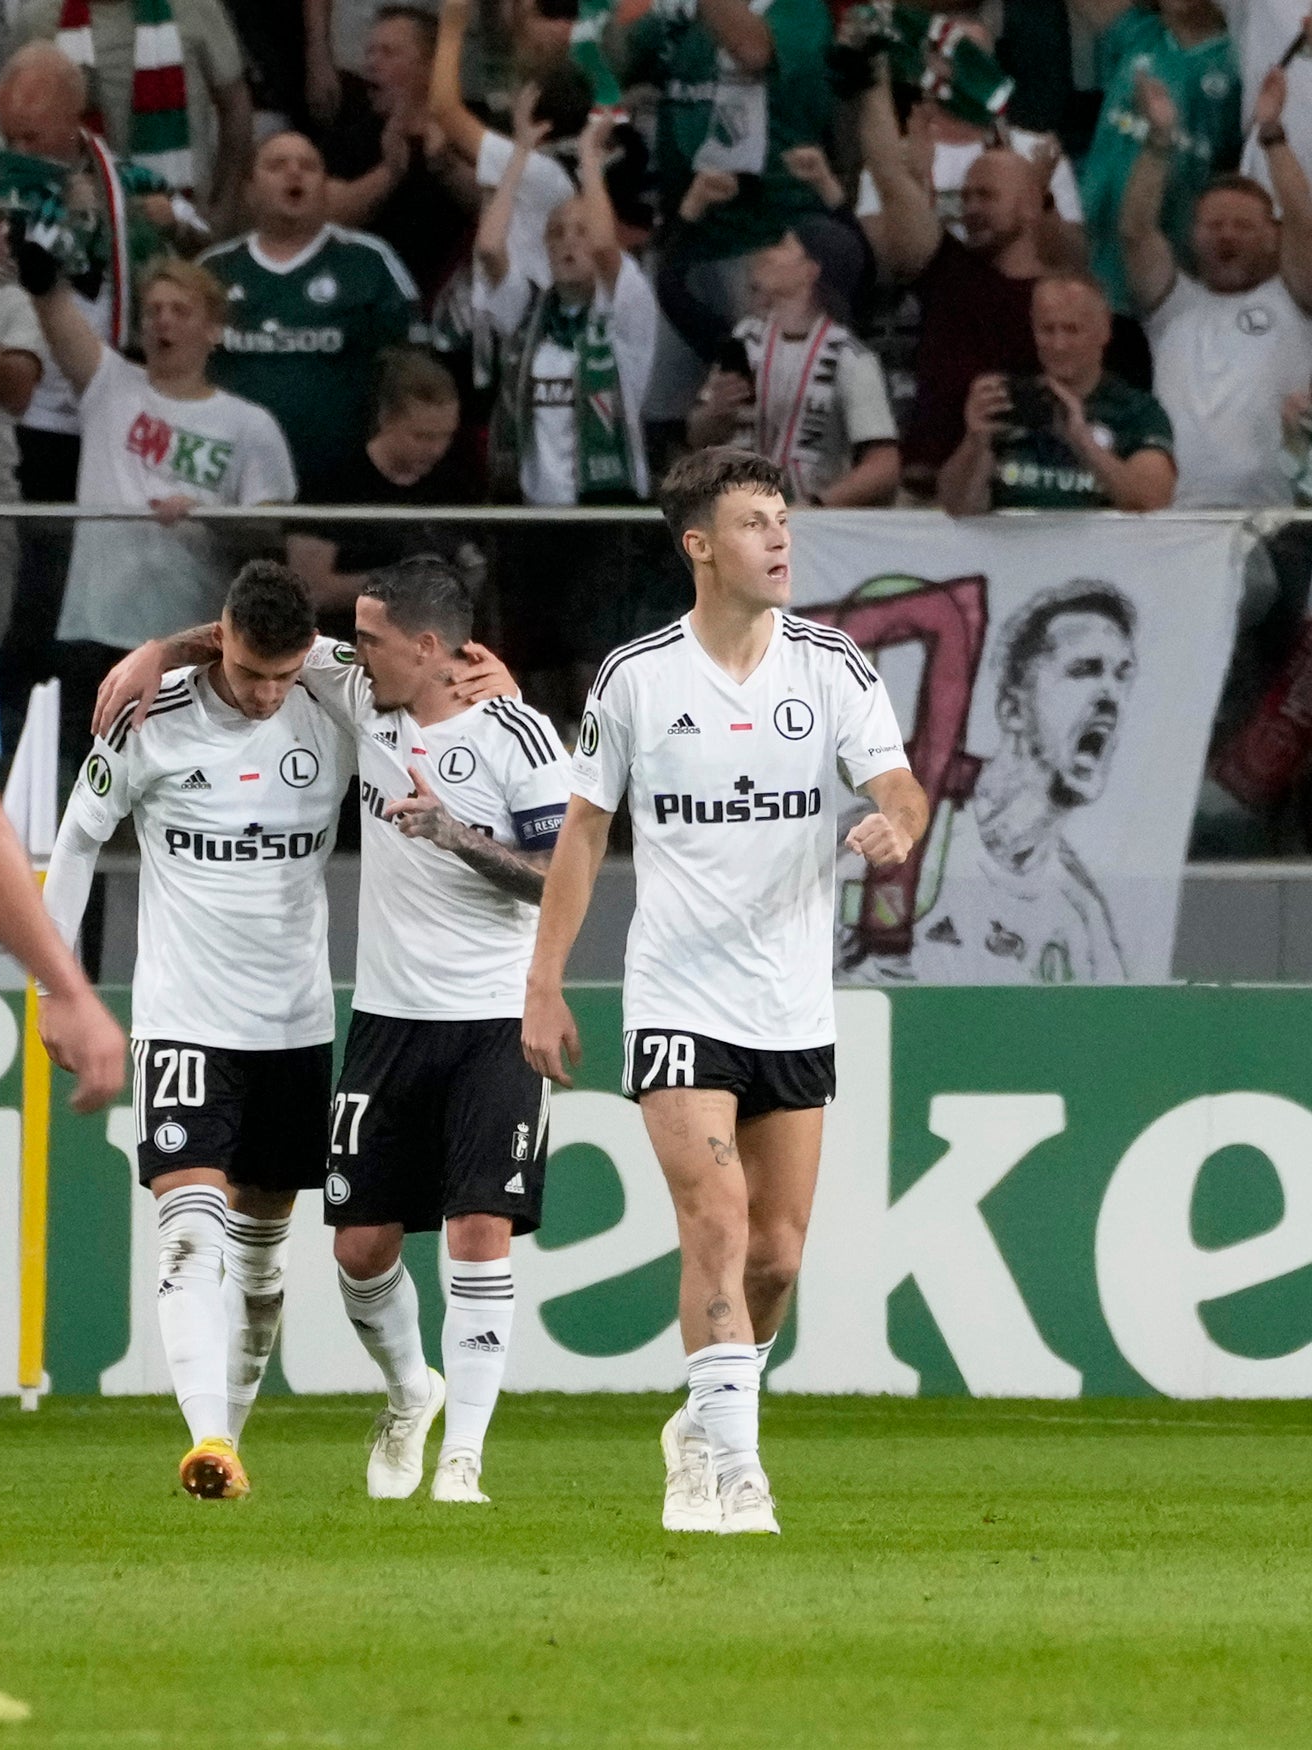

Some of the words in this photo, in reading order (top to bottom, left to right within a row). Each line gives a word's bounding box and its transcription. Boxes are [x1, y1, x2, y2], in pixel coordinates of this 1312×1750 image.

[653, 787, 821, 825] Plus500
[152, 1048, 206, 1109] 20
[330, 1092, 370, 1155] 27
